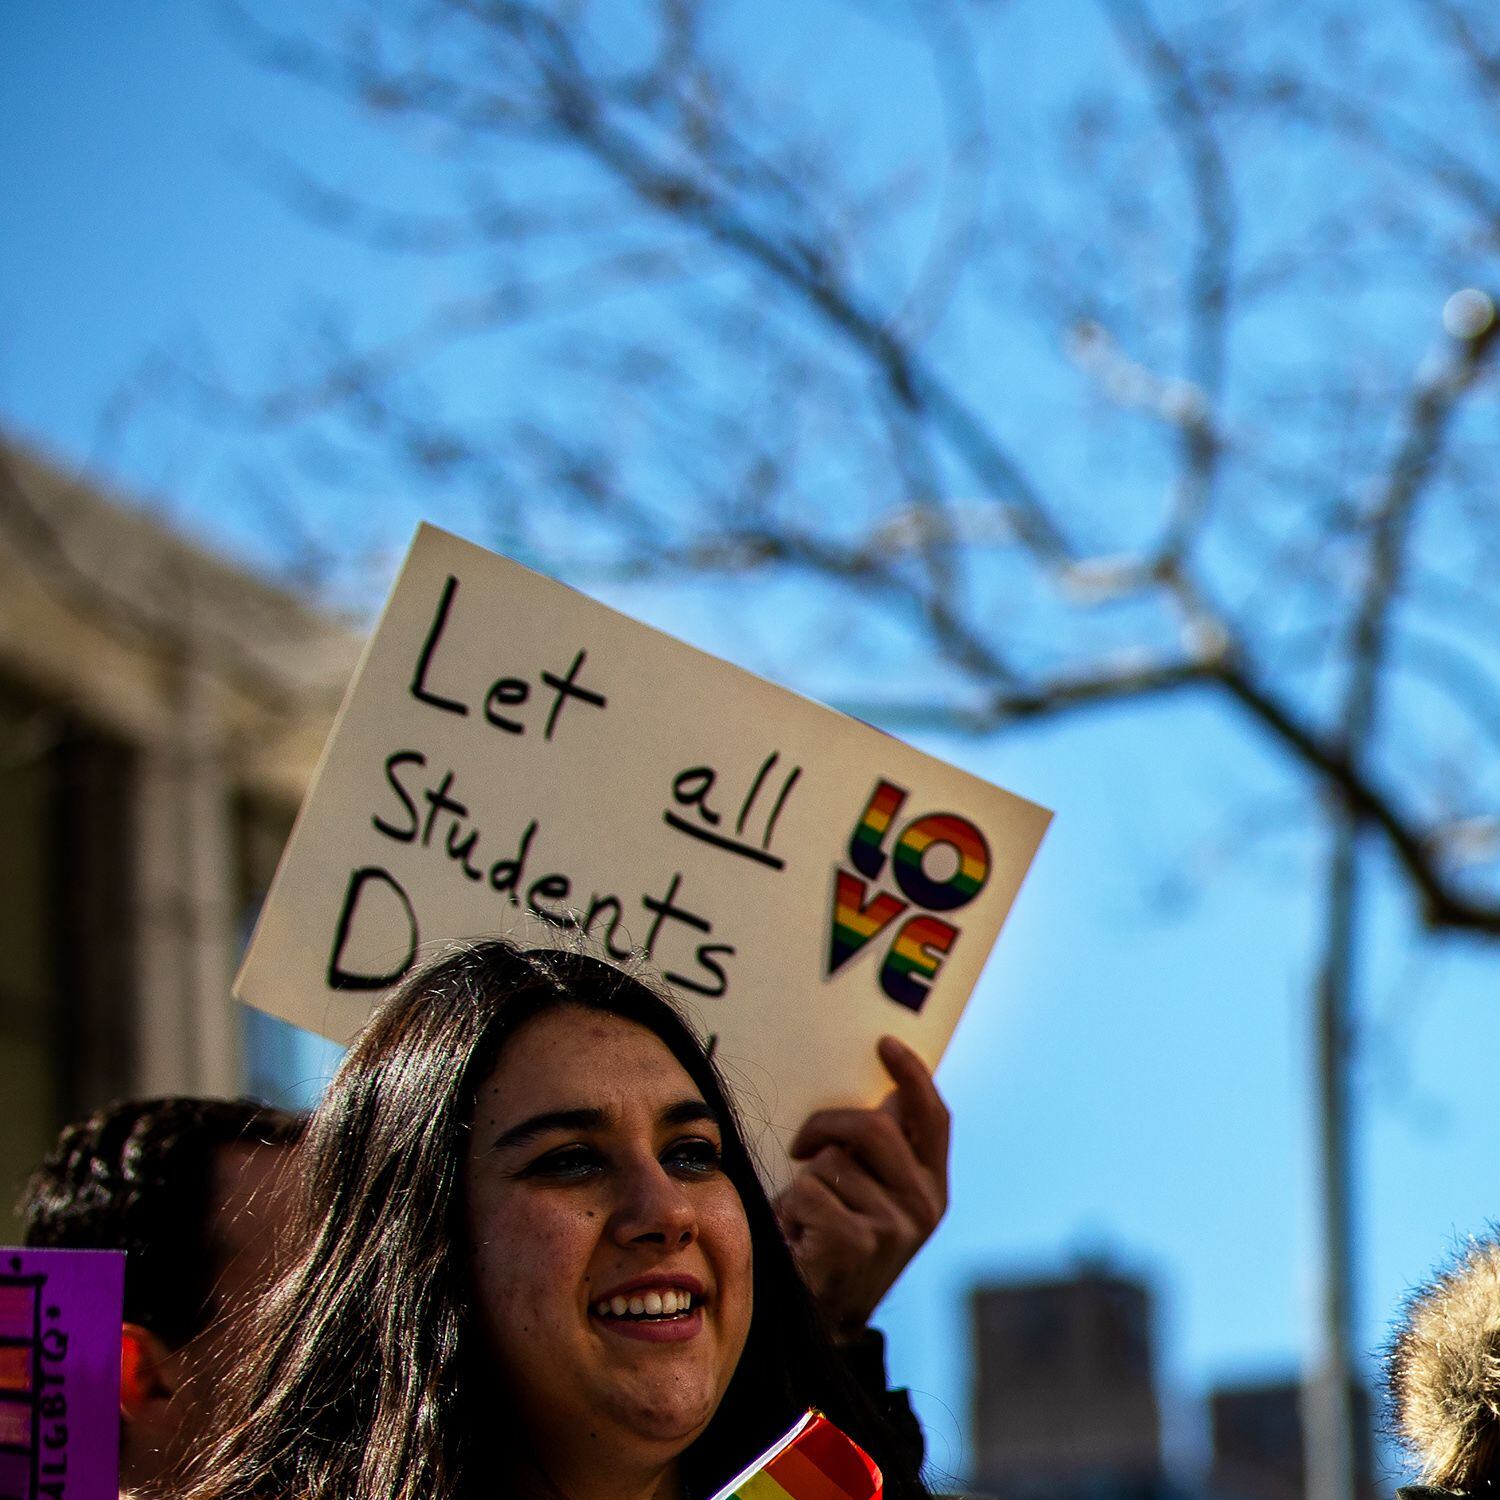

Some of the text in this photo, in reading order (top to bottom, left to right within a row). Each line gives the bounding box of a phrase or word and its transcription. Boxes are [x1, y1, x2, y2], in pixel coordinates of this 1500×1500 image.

[411, 575, 803, 855] Let all
[373, 750, 737, 997] Students
